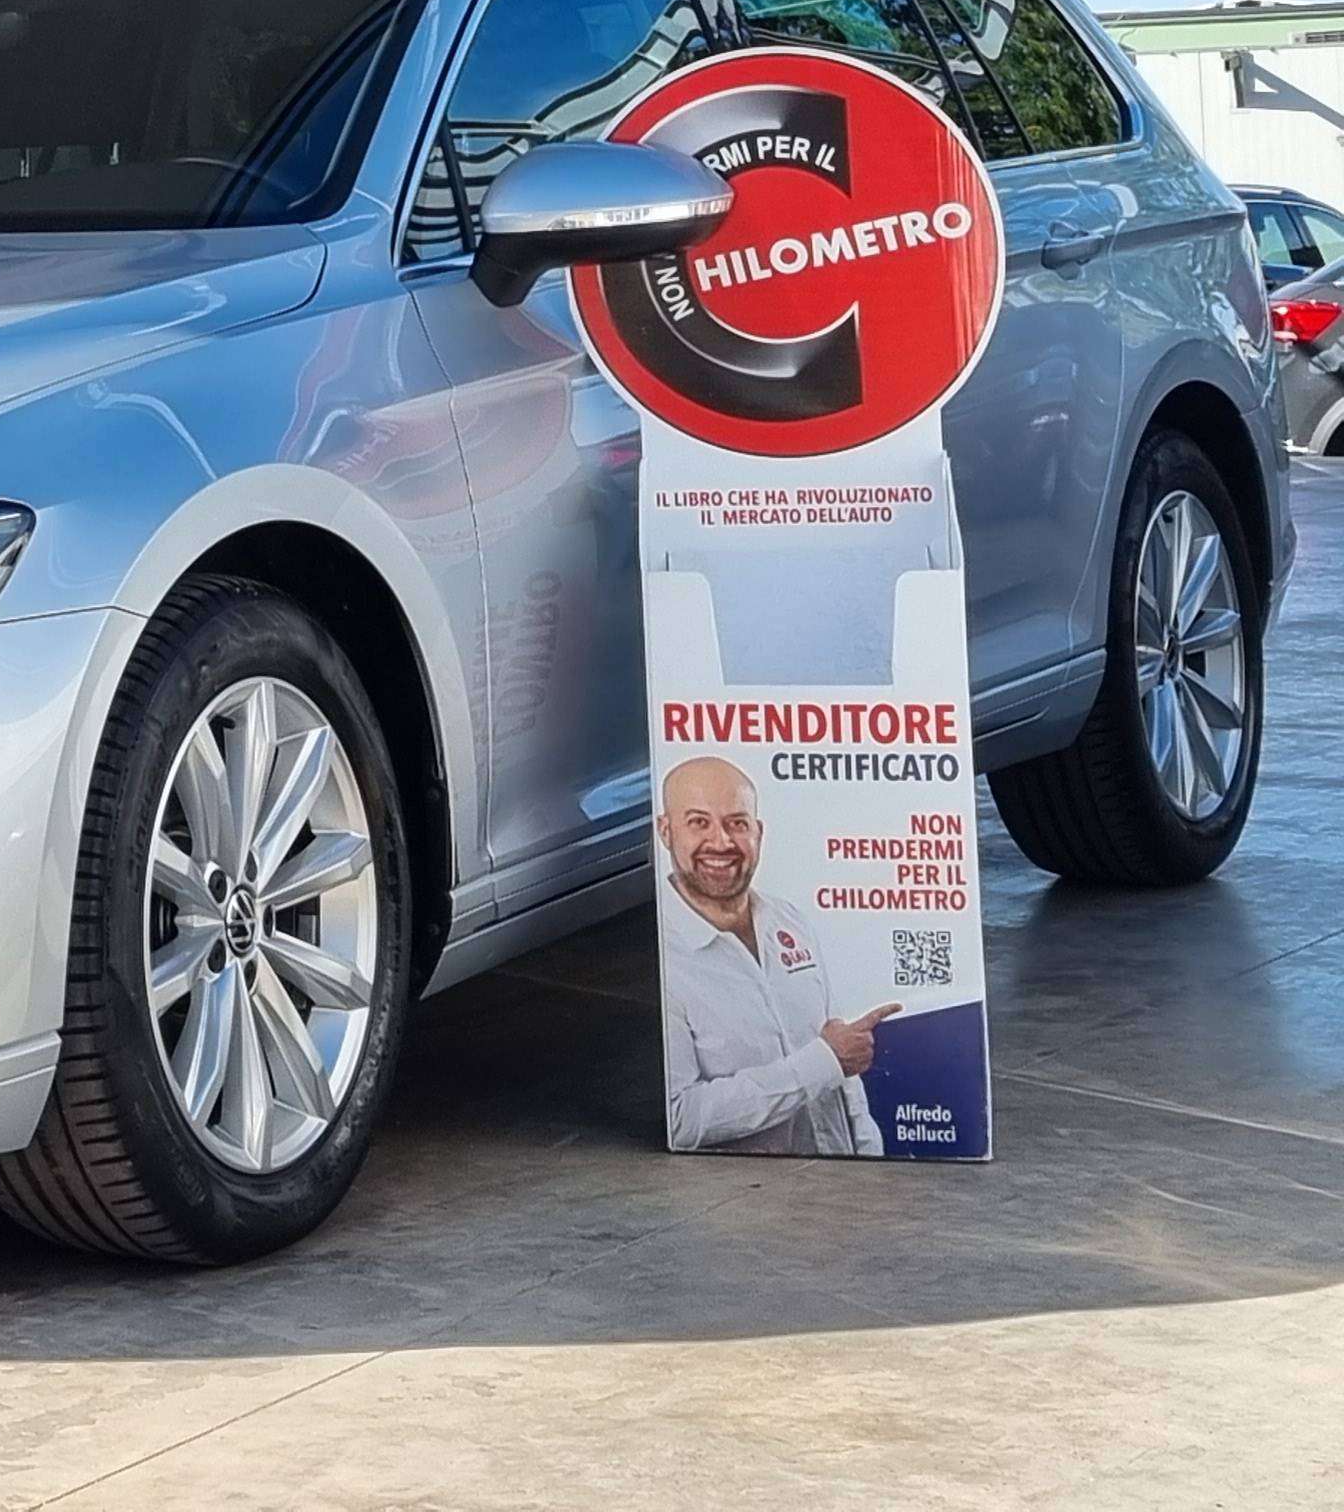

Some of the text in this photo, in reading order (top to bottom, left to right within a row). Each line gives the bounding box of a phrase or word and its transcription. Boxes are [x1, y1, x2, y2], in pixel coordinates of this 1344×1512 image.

[756, 135, 811, 162] PER
[815, 143, 836, 172] IL
[655, 266, 694, 321] NON
[656, 487, 933, 507] IL LIBRO CHE HA RIVOLUZIONATO
[701, 506, 893, 525] IL MERCATO DELL'AUTO
[663, 702, 958, 744] RIVENDITORE
[771, 753, 960, 783] CERTIFICATO
[911, 814, 962, 836] NON
[827, 839, 964, 861] PRENDERMI
[897, 864, 967, 886] PER IL
[816, 888, 967, 911] CHILOMETRO
[895, 1104, 952, 1123] Alfredo
[896, 1124, 957, 1142] Bellucci
